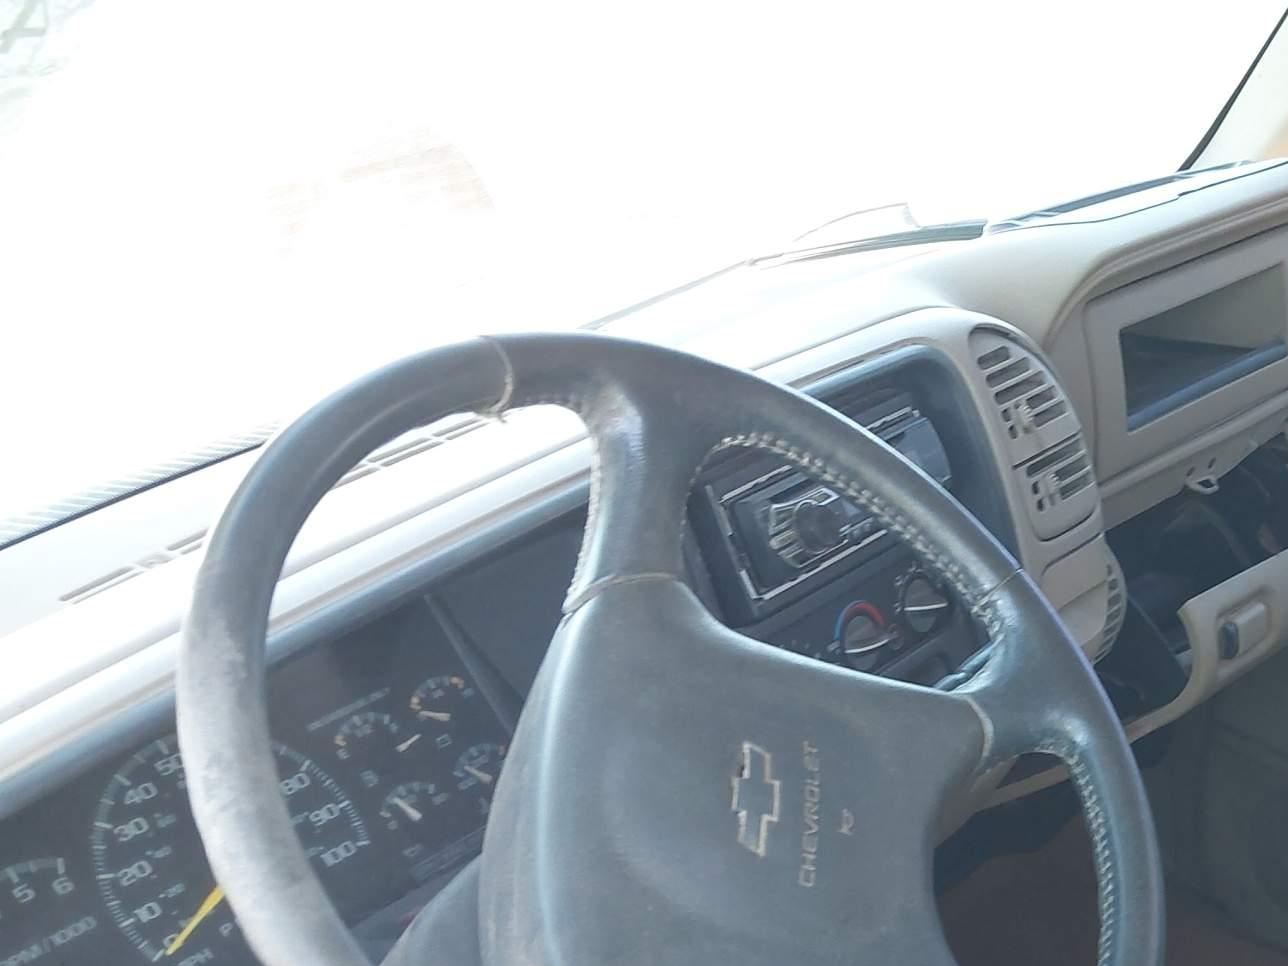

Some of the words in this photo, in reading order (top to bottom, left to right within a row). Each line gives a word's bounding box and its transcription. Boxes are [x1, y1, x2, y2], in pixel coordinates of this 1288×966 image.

[124, 782, 158, 805] 40
[280, 772, 311, 796] 80
[308, 803, 341, 826] 90
[798, 740, 820, 887] CHEVROLET
[113, 817, 149, 842] 30
[320, 840, 358, 867] 100
[117, 860, 153, 887] 20
[12, 883, 36, 904] 5
[52, 877, 76, 896] 6
[133, 901, 163, 924] 10
